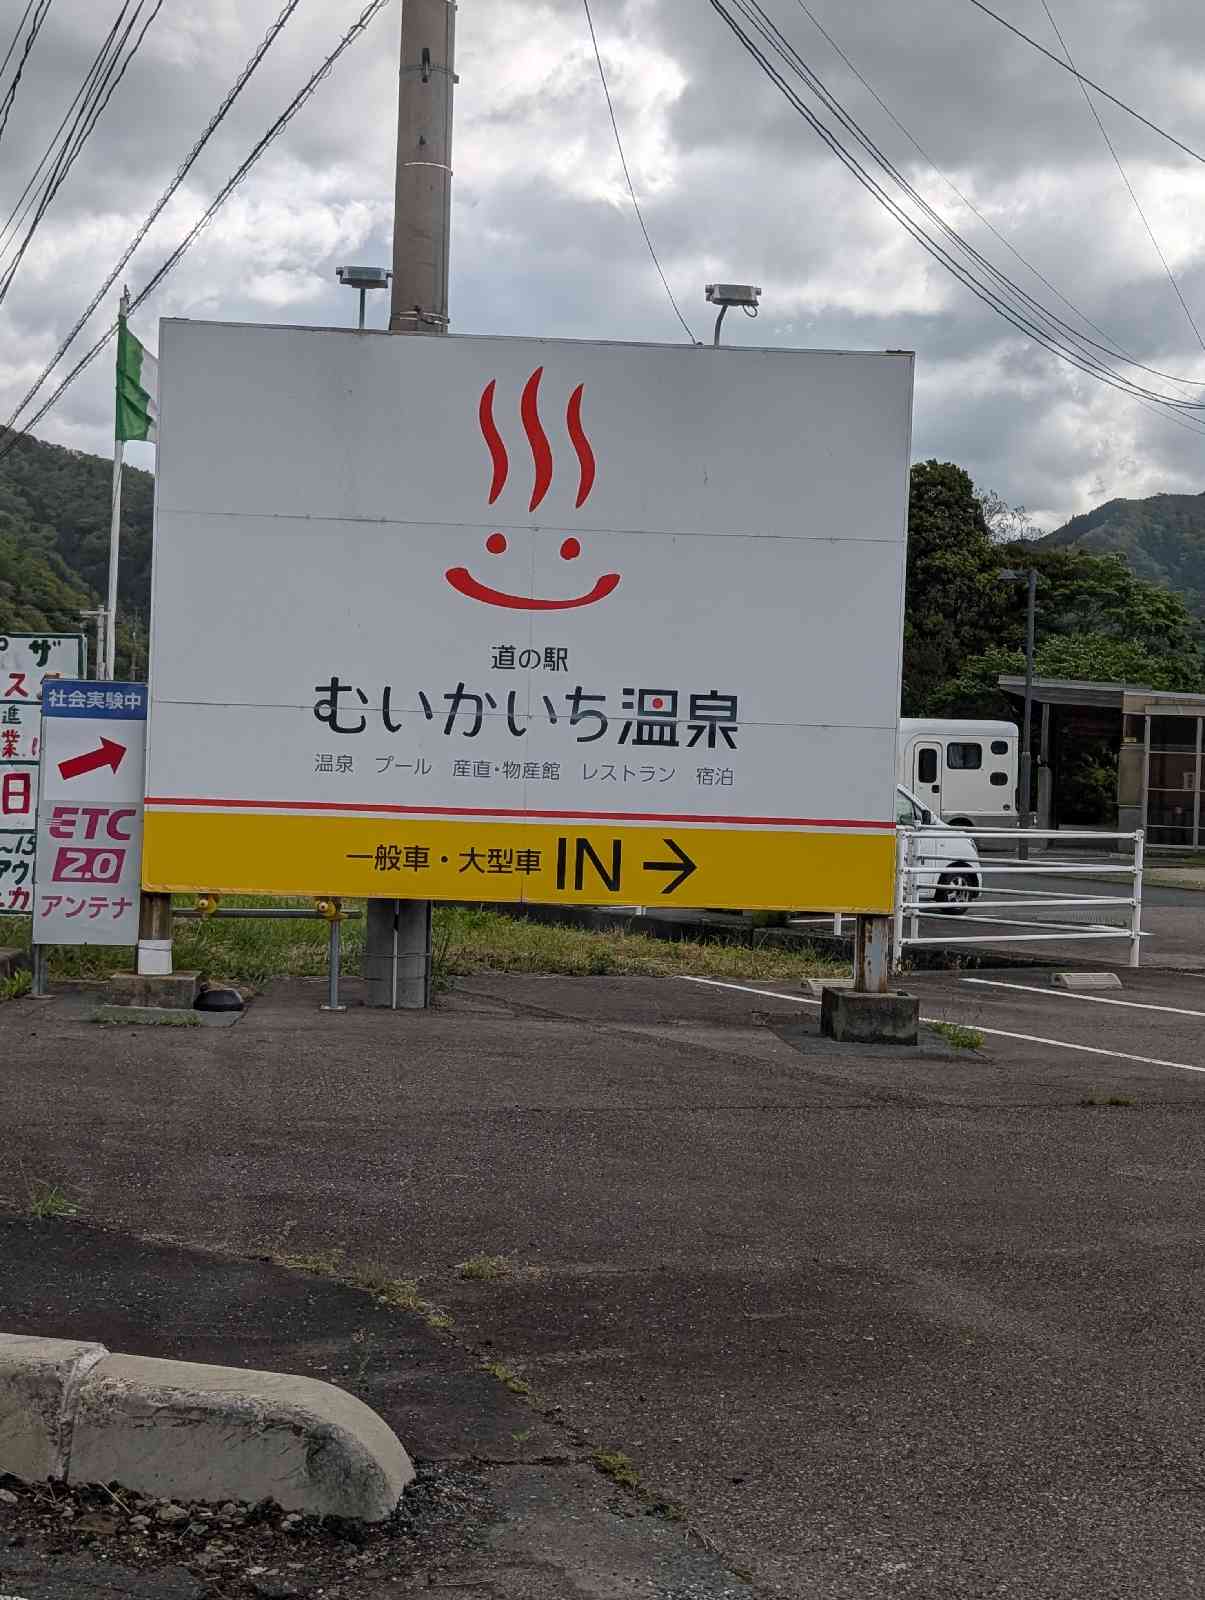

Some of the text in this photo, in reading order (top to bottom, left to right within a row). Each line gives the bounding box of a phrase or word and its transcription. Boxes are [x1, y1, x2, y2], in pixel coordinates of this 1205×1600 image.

[491, 645, 569, 672] 道の駅
[48, 690, 143, 711] 社会実験中
[313, 677, 739, 749] むいかいち温泉
[314, 753, 735, 786] 温泉 プール 産直・物産館 レストラン 宿泊
[49, 807, 136, 841] ETC
[59, 850, 119, 880] 2.0
[346, 837, 622, 892] 一般車・大型車 IN
[41, 896, 133, 919] アンテナ
